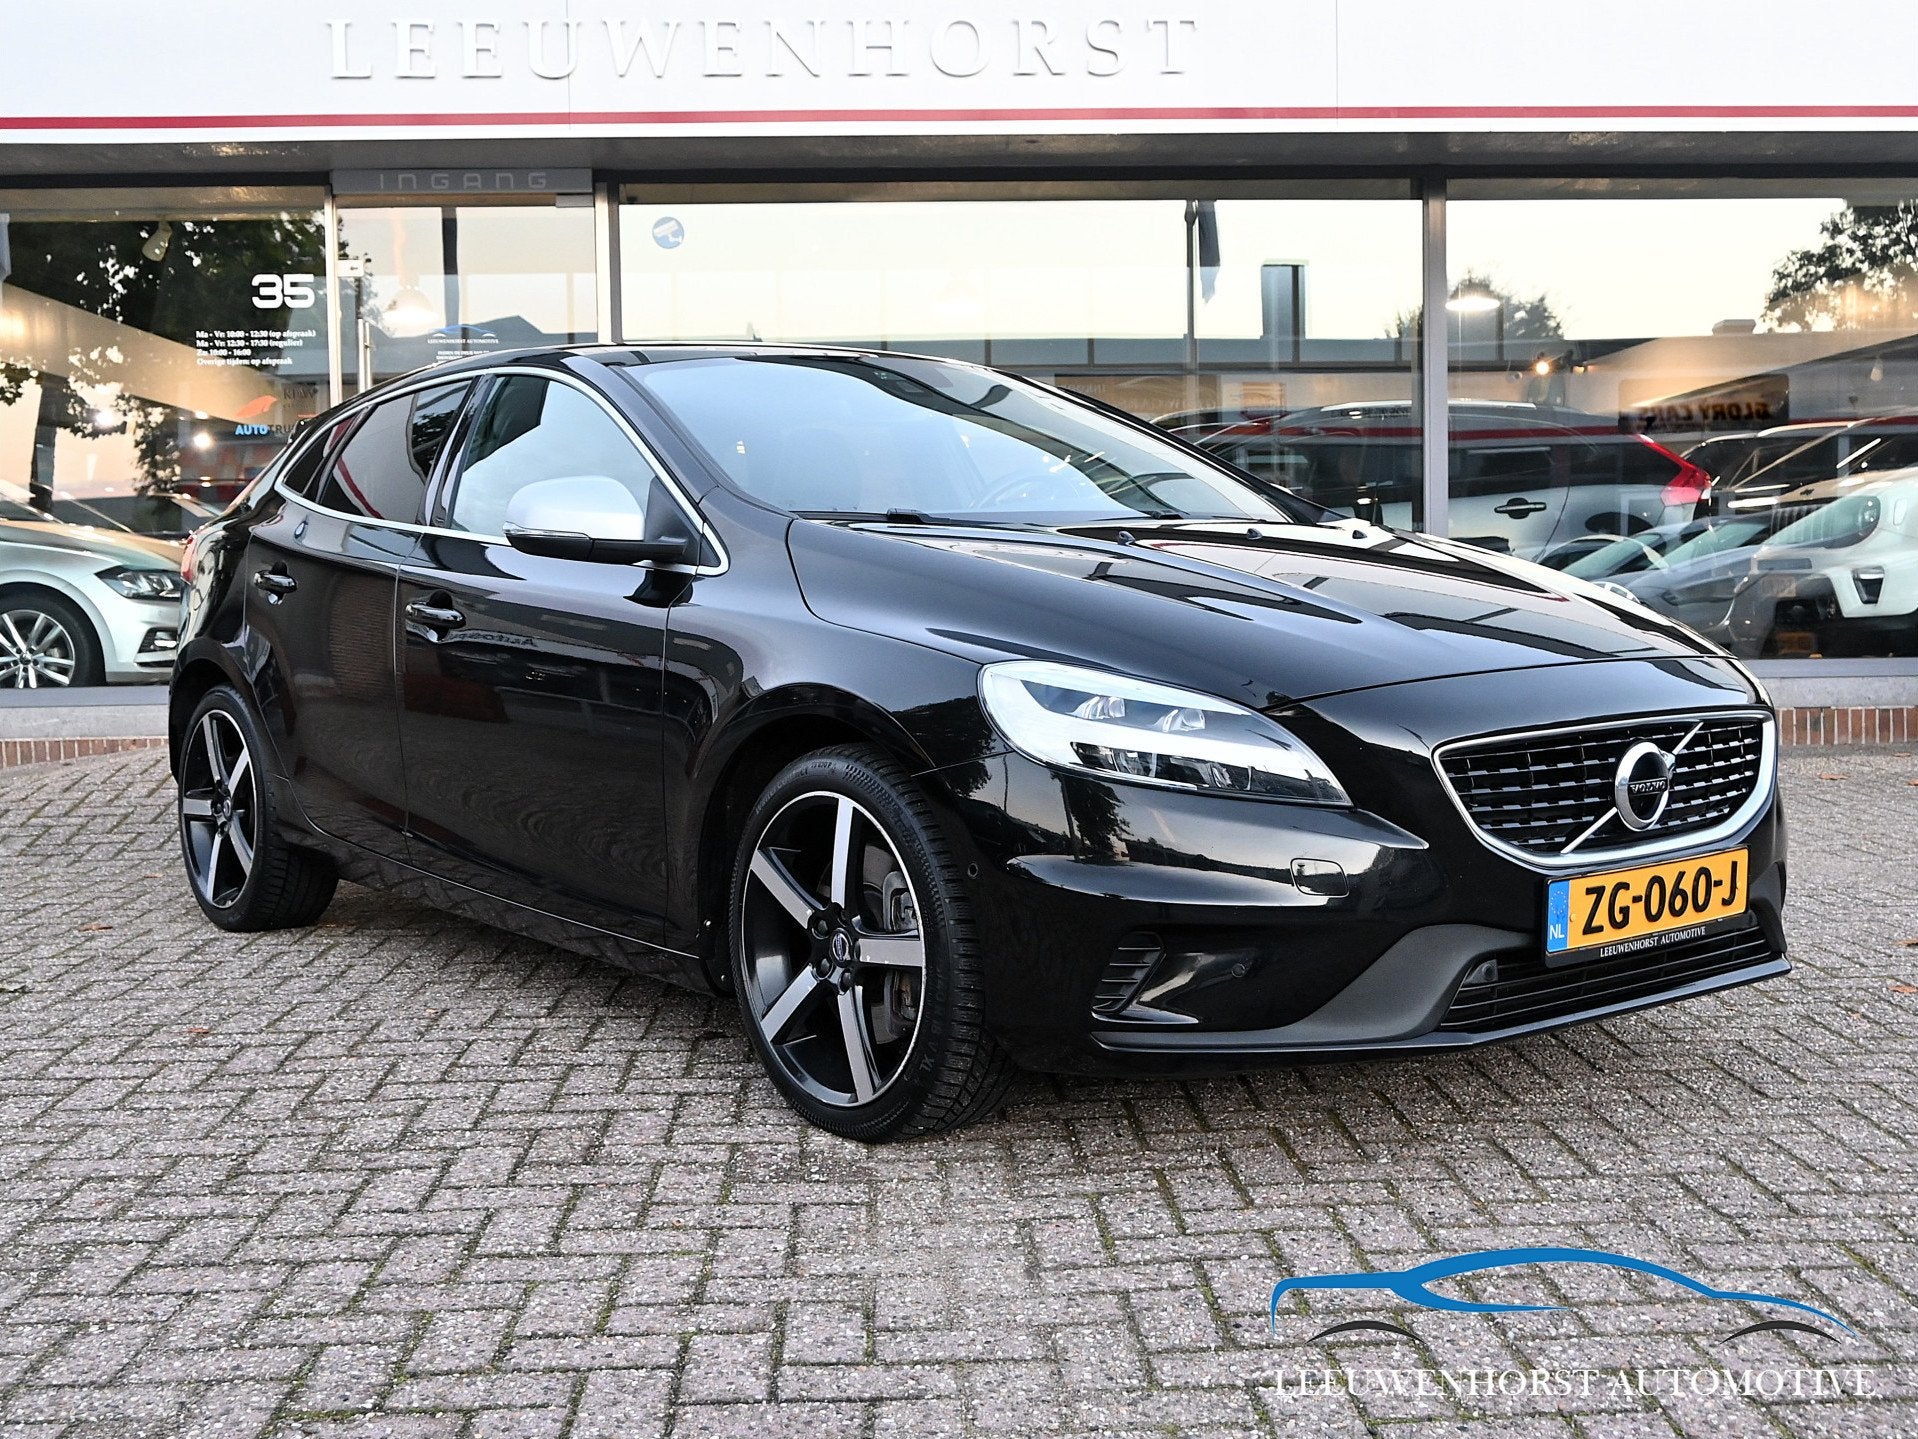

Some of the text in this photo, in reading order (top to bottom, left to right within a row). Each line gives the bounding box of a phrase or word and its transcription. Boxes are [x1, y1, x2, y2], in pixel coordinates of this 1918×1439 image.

[326, 17, 1197, 81] LEEUWENHORST
[379, 172, 547, 190] INGANG
[252, 273, 315, 309] 35
[195, 330, 208, 338] Ma
[226, 330, 245, 338] 10:00
[250, 330, 268, 338] 12:30
[269, 330, 281, 340] (op
[196, 339, 209, 347] Ma
[226, 339, 245, 347] 12:30
[250, 339, 268, 347] 17:30
[233, 348, 251, 356] 16:00
[261, 357, 293, 366] afspraak
[1630, 780, 1666, 794] VOLVO
[1582, 861, 1738, 936] ZG-060-J
[1549, 924, 1565, 940] NL
[1600, 926, 1706, 958] LEEUWENHORST AUTOMOTIVE
